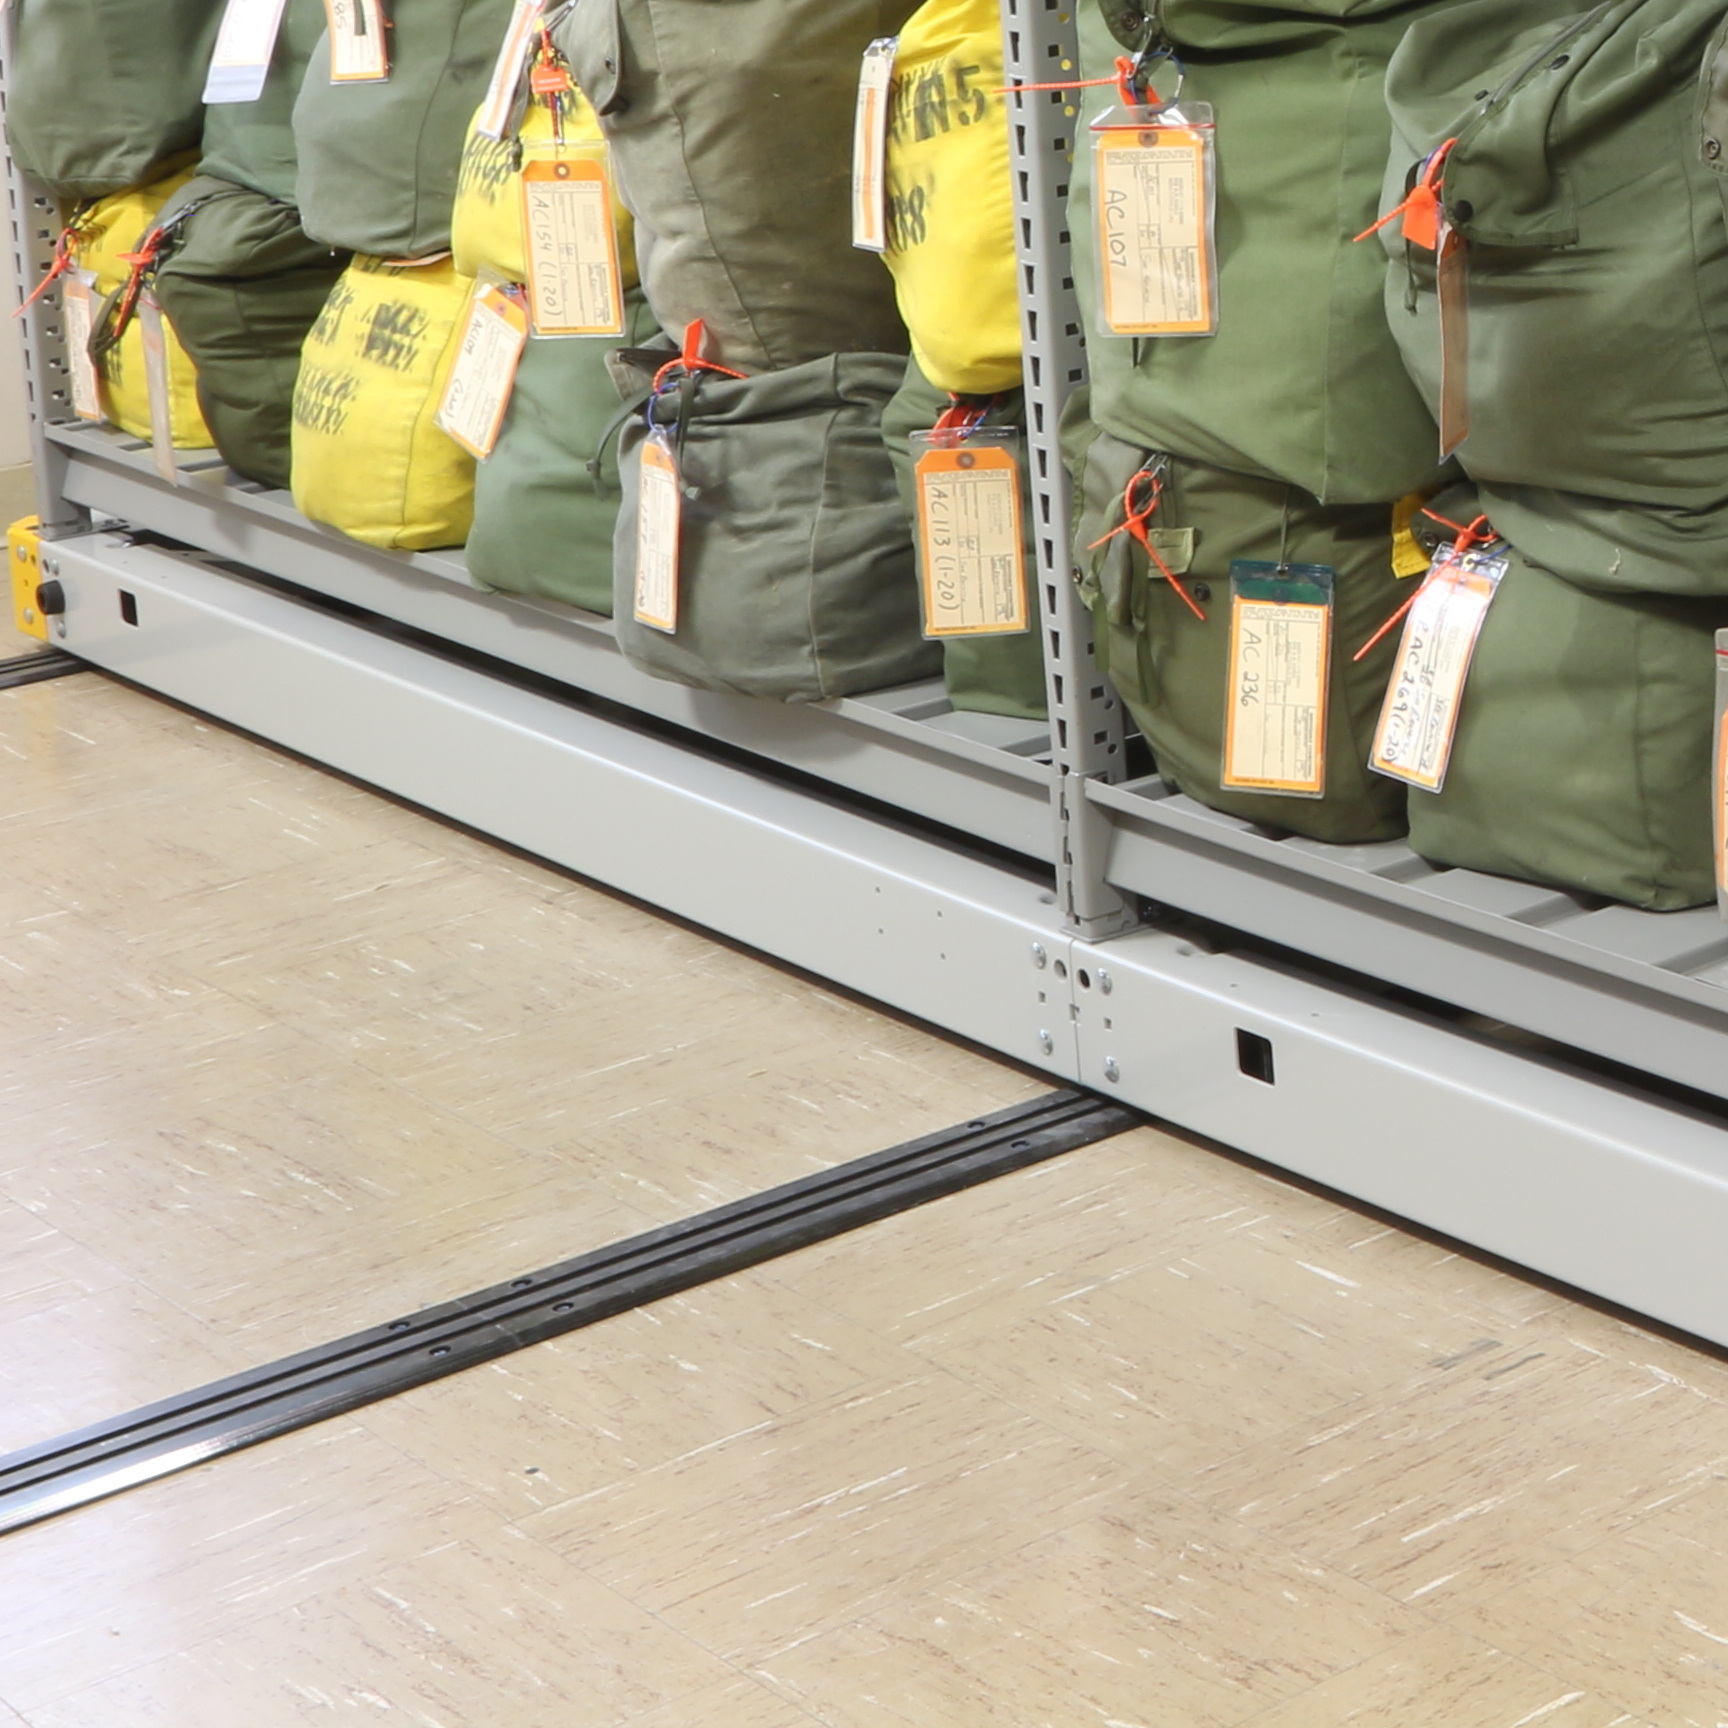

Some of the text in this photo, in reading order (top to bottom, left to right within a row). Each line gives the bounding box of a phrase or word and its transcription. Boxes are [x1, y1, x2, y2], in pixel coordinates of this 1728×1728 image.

[531, 194, 553, 252] AC154
[1104, 189, 1128, 268] AC107
[933, 555, 961, 611] (1-20)
[1240, 627, 1263, 708] AC 236
